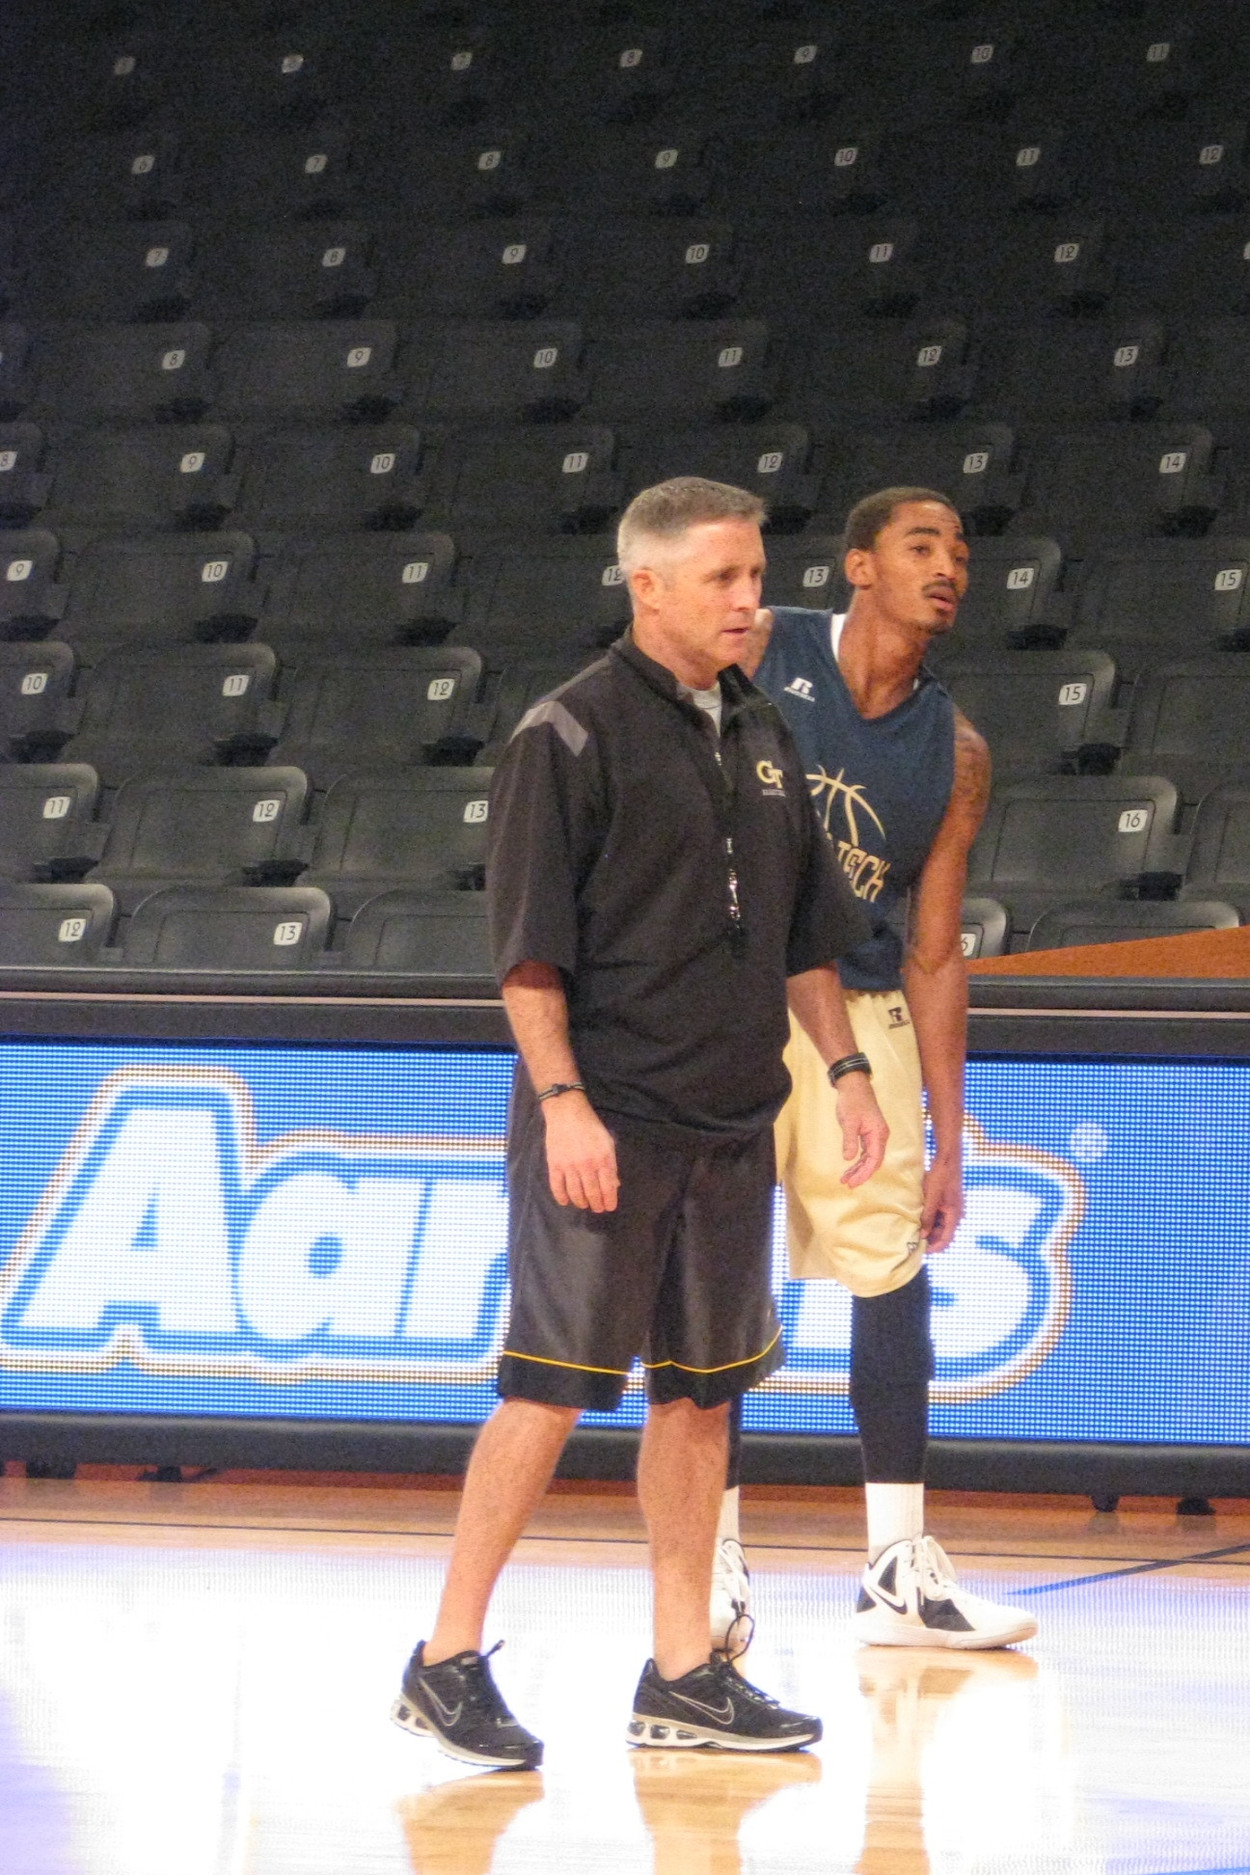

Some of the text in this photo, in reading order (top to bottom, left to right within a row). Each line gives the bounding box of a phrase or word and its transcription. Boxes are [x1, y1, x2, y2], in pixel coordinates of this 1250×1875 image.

[838, 148, 855, 164] 10
[1020, 148, 1037, 164] 11
[1203, 145, 1221, 162] 12
[689, 245, 707, 261] 10
[874, 244, 889, 260] 11
[1059, 243, 1077, 260] 12
[537, 349, 555, 366] 10
[723, 348, 739, 364] 11
[922, 346, 939, 364] 12
[1118, 346, 1136, 364] 13
[374, 454, 392, 471] 10
[567, 453, 584, 470] 11
[762, 453, 780, 471] 12
[968, 453, 985, 471] 13
[1164, 454, 1182, 470] 14
[206, 562, 225, 579] 10
[408, 563, 424, 580] 11
[807, 566, 826, 585] 13
[1012, 569, 1030, 586] 14
[1219, 570, 1238, 588] 15
[26, 674, 44, 692] 10
[228, 676, 244, 692] 11
[432, 679, 451, 698] 12
[1064, 684, 1082, 703] 15
[49, 797, 66, 815] 11
[257, 800, 277, 819] 12
[469, 801, 488, 820] 13
[1124, 811, 1142, 830] 16
[64, 920, 83, 939] 12
[279, 923, 298, 942] 13
